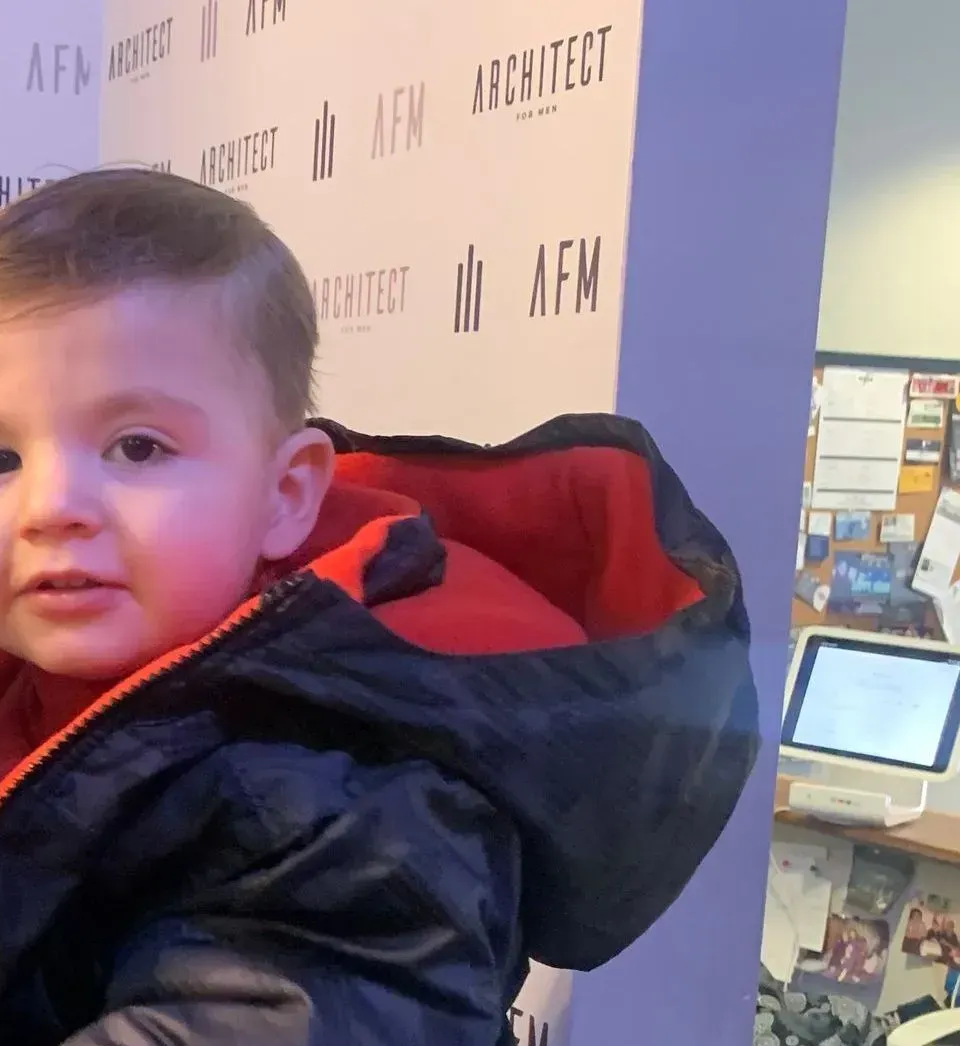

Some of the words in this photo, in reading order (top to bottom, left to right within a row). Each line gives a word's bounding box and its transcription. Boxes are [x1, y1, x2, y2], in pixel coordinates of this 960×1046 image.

[108, 17, 173, 81] ARCHITECT
[472, 25, 612, 115] ARCHITECT
[371, 81, 426, 160] AFM
[516, 110, 533, 121] FOR
[538, 104, 557, 116] MEN
[200, 126, 279, 185] ARCHITECT
[529, 235, 602, 317] AFM
